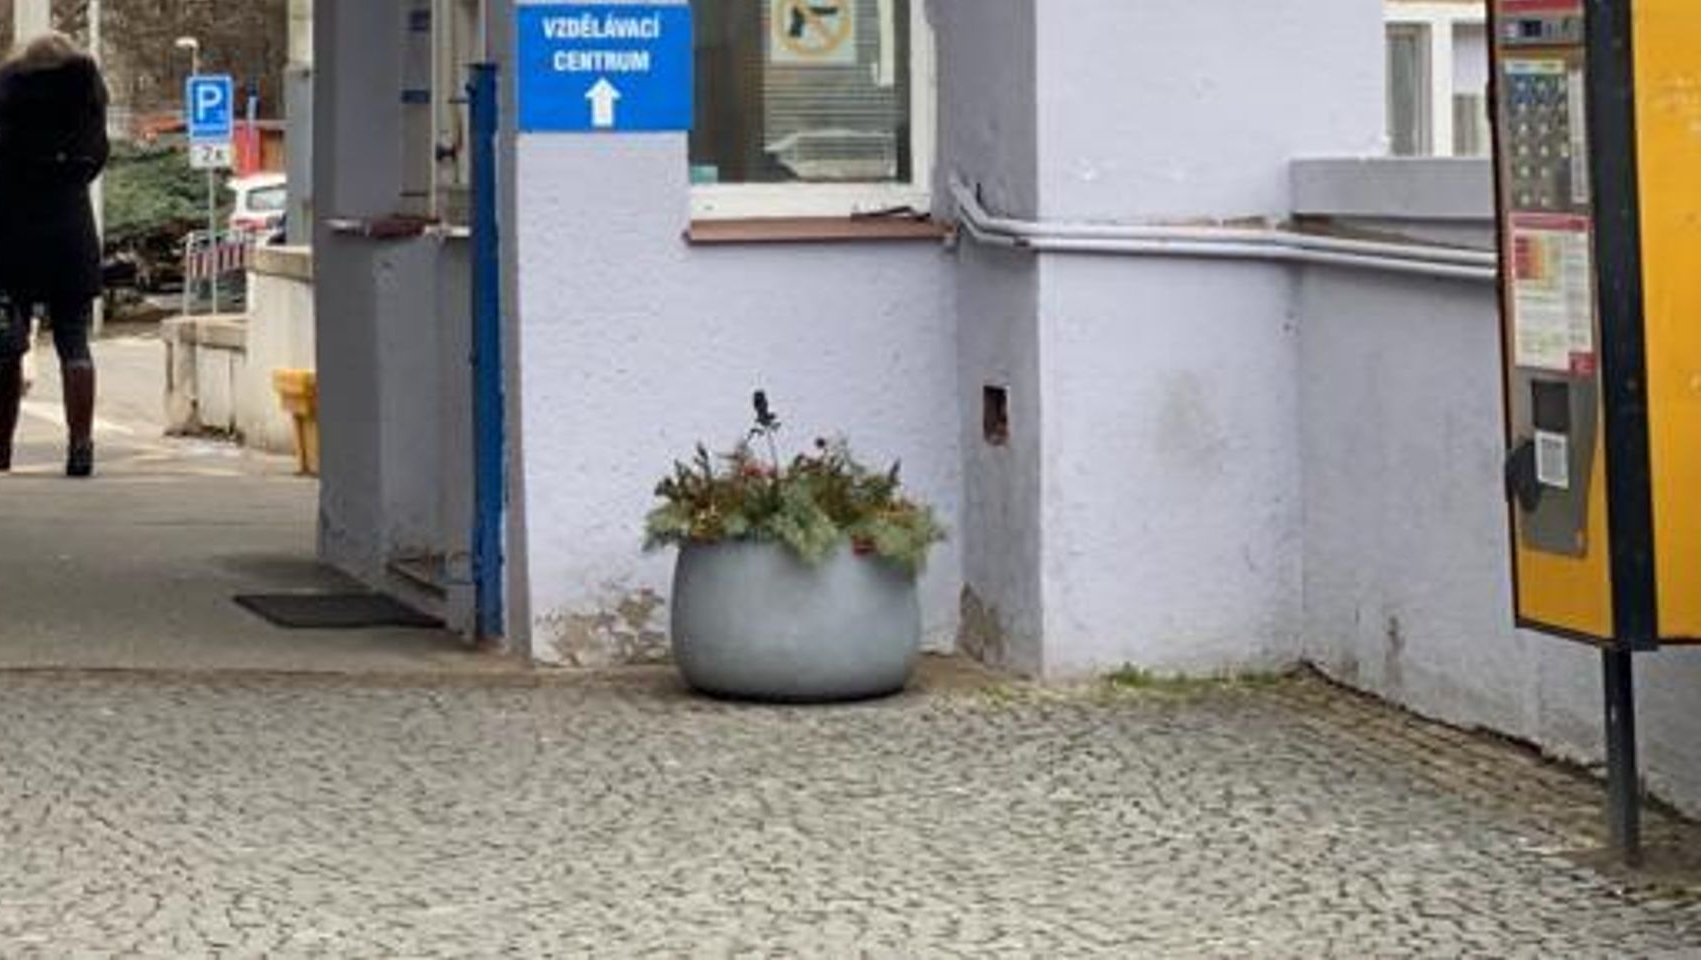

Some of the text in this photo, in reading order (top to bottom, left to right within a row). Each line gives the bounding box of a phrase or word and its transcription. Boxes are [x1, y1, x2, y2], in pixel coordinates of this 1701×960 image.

[542, 13, 661, 40] VZDĚLÁVACÍ
[553, 50, 651, 72] CENTRUM
[197, 85, 223, 121] P
